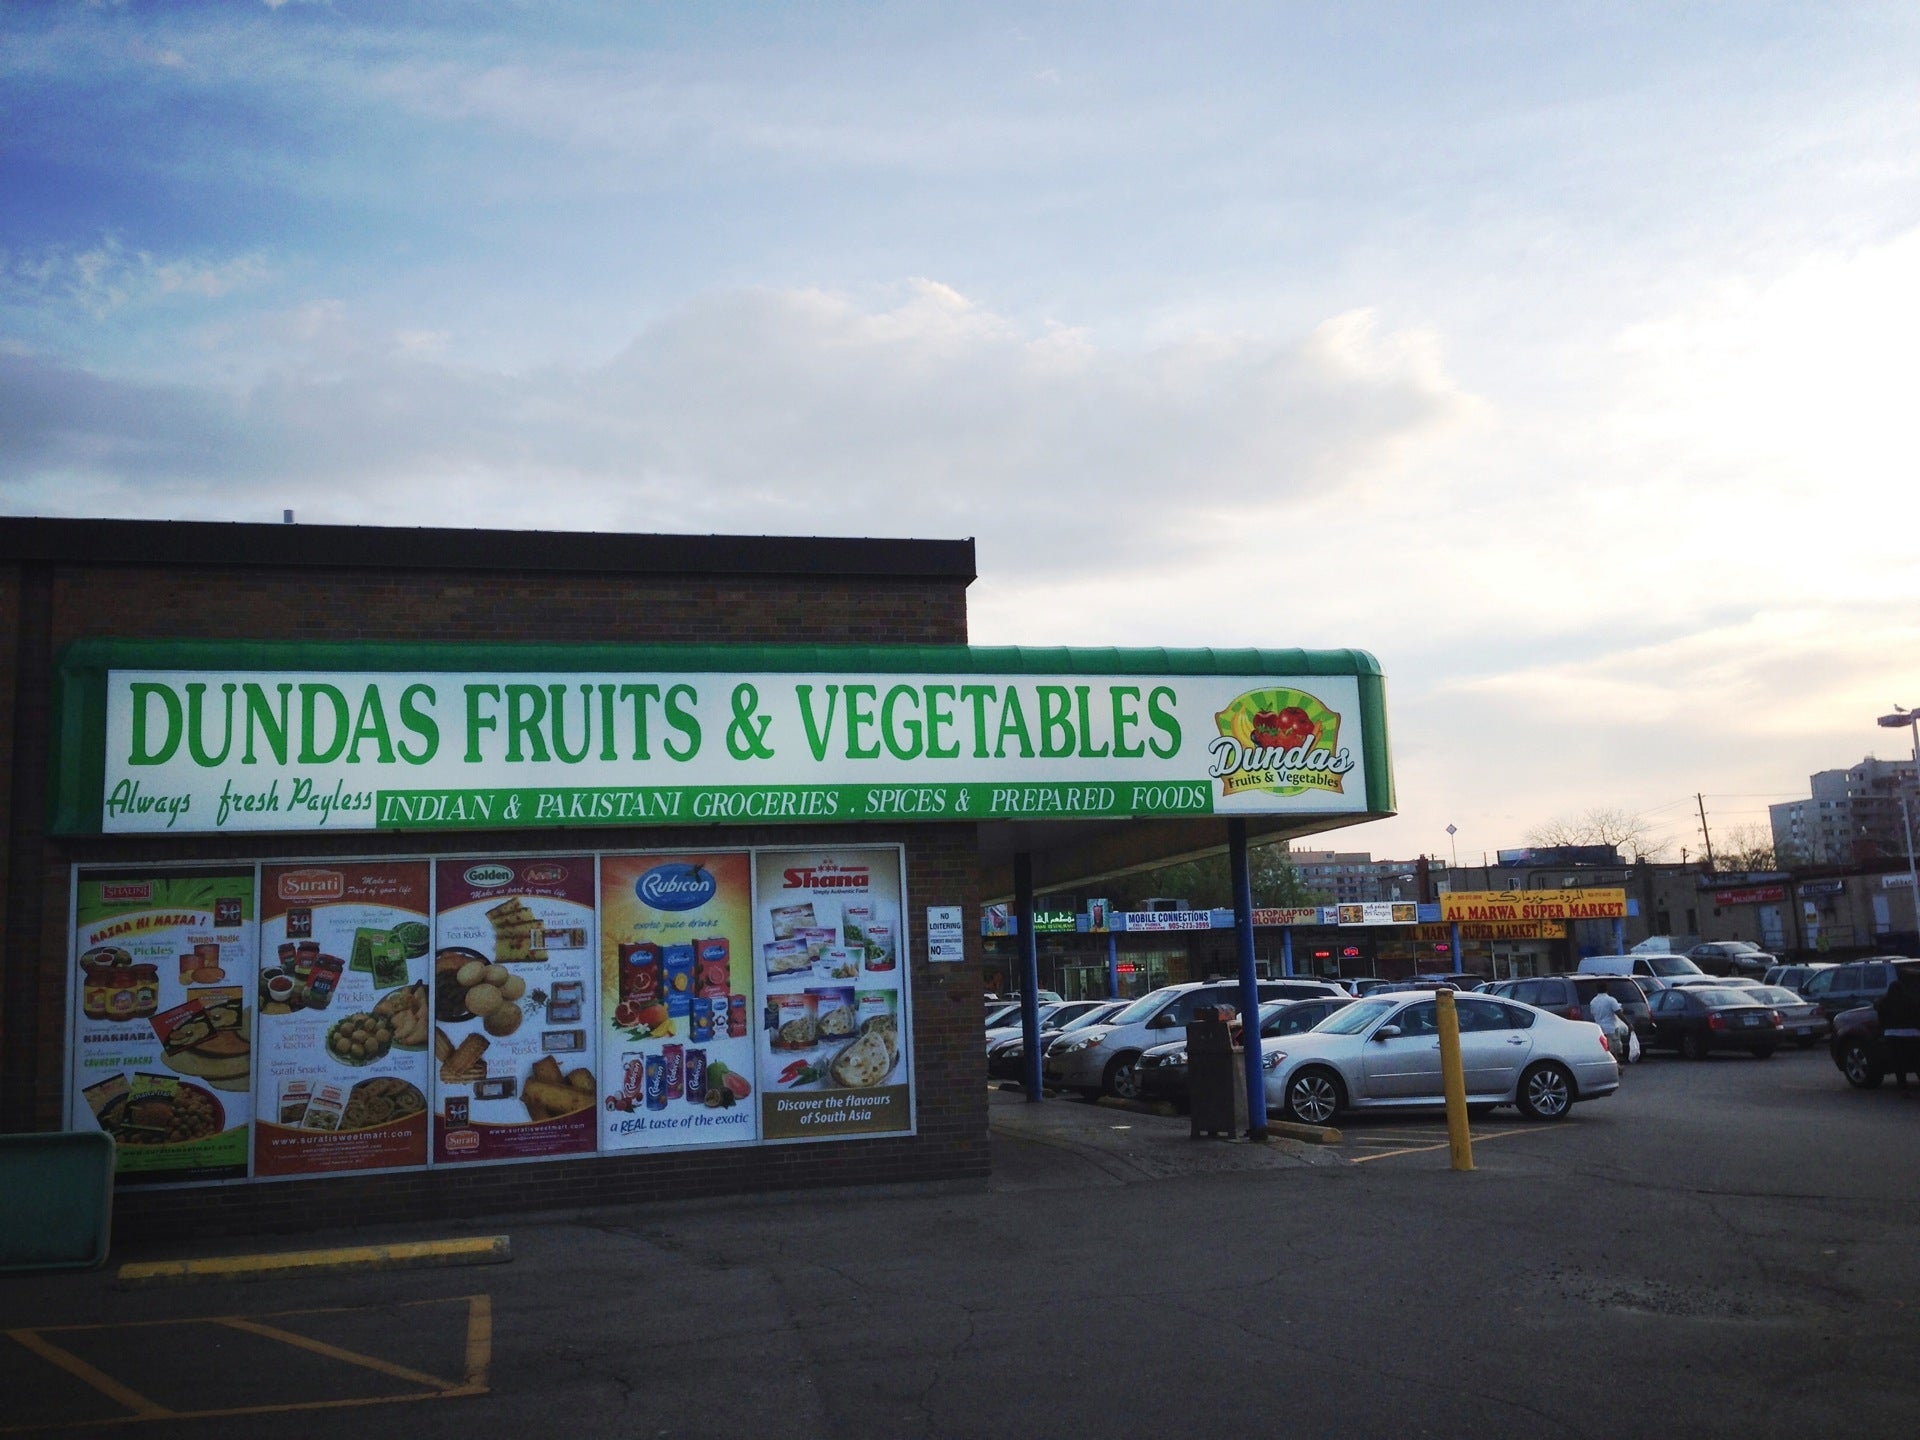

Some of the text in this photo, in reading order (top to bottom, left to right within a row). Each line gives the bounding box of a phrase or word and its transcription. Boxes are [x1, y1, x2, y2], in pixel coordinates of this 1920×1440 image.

[128, 682, 1182, 767] DUNDAS FRUITS & VEGETABLES
[1208, 734, 1354, 778] Dundas
[1228, 771, 1339, 789] Fruits & Vegetables
[106, 778, 373, 828] Always fresh Payless
[381, 795, 493, 822] INDIAN
[503, 794, 522, 820] &
[534, 791, 682, 818] PAKISTANI
[692, 790, 839, 817] GROCERIES
[864, 788, 946, 813] SPICES
[954, 788, 971, 812] &
[990, 787, 1115, 812] PREPARED
[1130, 785, 1207, 811] FOODS
[362, 876, 385, 886] Make
[469, 870, 510, 881] Golden
[783, 866, 870, 888] Shana
[284, 877, 339, 895] Surati
[346, 886, 411, 897] Part of your life
[470, 889, 495, 899] Make
[525, 886, 533, 896] of
[535, 888, 552, 896] your
[553, 888, 568, 898] life
[641, 873, 710, 902] Rubicon
[812, 888, 830, 896] Simply
[940, 912, 950, 920] NO
[1128, 911, 1209, 924] MOBILE CONNECTIONS
[1447, 902, 1624, 920] AL MARWA SUPER MARKET
[566, 917, 586, 926] Cake
[633, 918, 718, 933] exotic juice drinks
[929, 922, 962, 931] LOITERING
[1252, 916, 1296, 925] BLOWOUT
[89, 922, 132, 945] MAZAA
[136, 916, 150, 930] HI
[154, 914, 196, 927] MAZAA
[446, 930, 487, 939] Tea Rusks
[1462, 923, 1494, 940] SUPER
[1496, 922, 1539, 939] MARKET
[187, 935, 214, 945] Mango
[216, 934, 241, 945] Magic
[133, 945, 175, 956] Pickles
[930, 945, 942, 956] NO
[337, 991, 375, 1004] Pickles
[297, 1065, 327, 1074] Snacks
[666, 1053, 681, 1086] Rubicon
[688, 1058, 703, 1091] Rubicon
[623, 1062, 640, 1099] Rubicon
[648, 1065, 664, 1097] Rubicon
[777, 1094, 891, 1112] Discover the flavours
[610, 1111, 750, 1133] a REAL taste of the exotic
[800, 1108, 872, 1125] of South Asia
[271, 1130, 413, 1147] www.suratisweetmart.com
[447, 1136, 478, 1146] Surati
